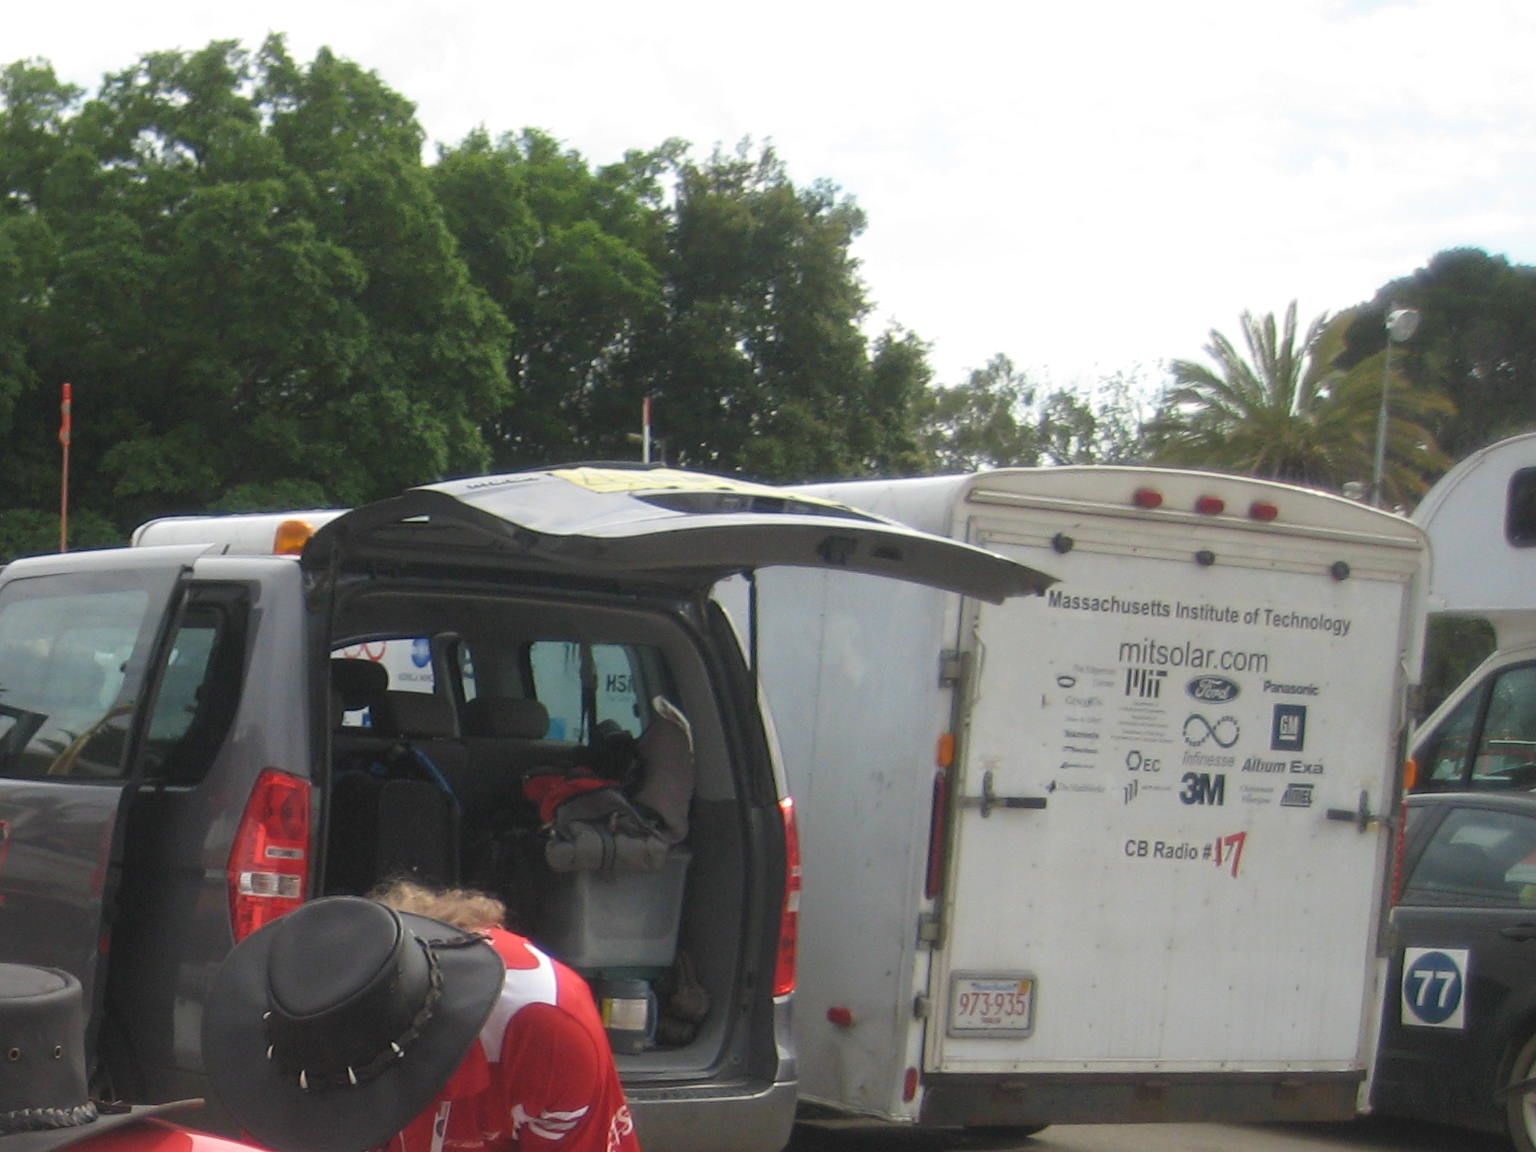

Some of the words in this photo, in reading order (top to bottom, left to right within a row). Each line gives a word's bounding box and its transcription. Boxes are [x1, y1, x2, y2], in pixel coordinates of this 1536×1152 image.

[1048, 589, 1171, 618] Massachusetts
[1175, 601, 1240, 624] Institute
[1243, 607, 1261, 626] of
[1264, 609, 1352, 637] Technology
[1118, 637, 1269, 674] mitsolar.com
[1194, 678, 1233, 700] Ford
[1264, 680, 1320, 697] Panasonic
[1280, 715, 1299, 734] GM
[1179, 771, 1226, 807] 3M
[1124, 839, 1148, 857] CB
[1154, 841, 1198, 860] Radio
[1413, 969, 1456, 1008] 77
